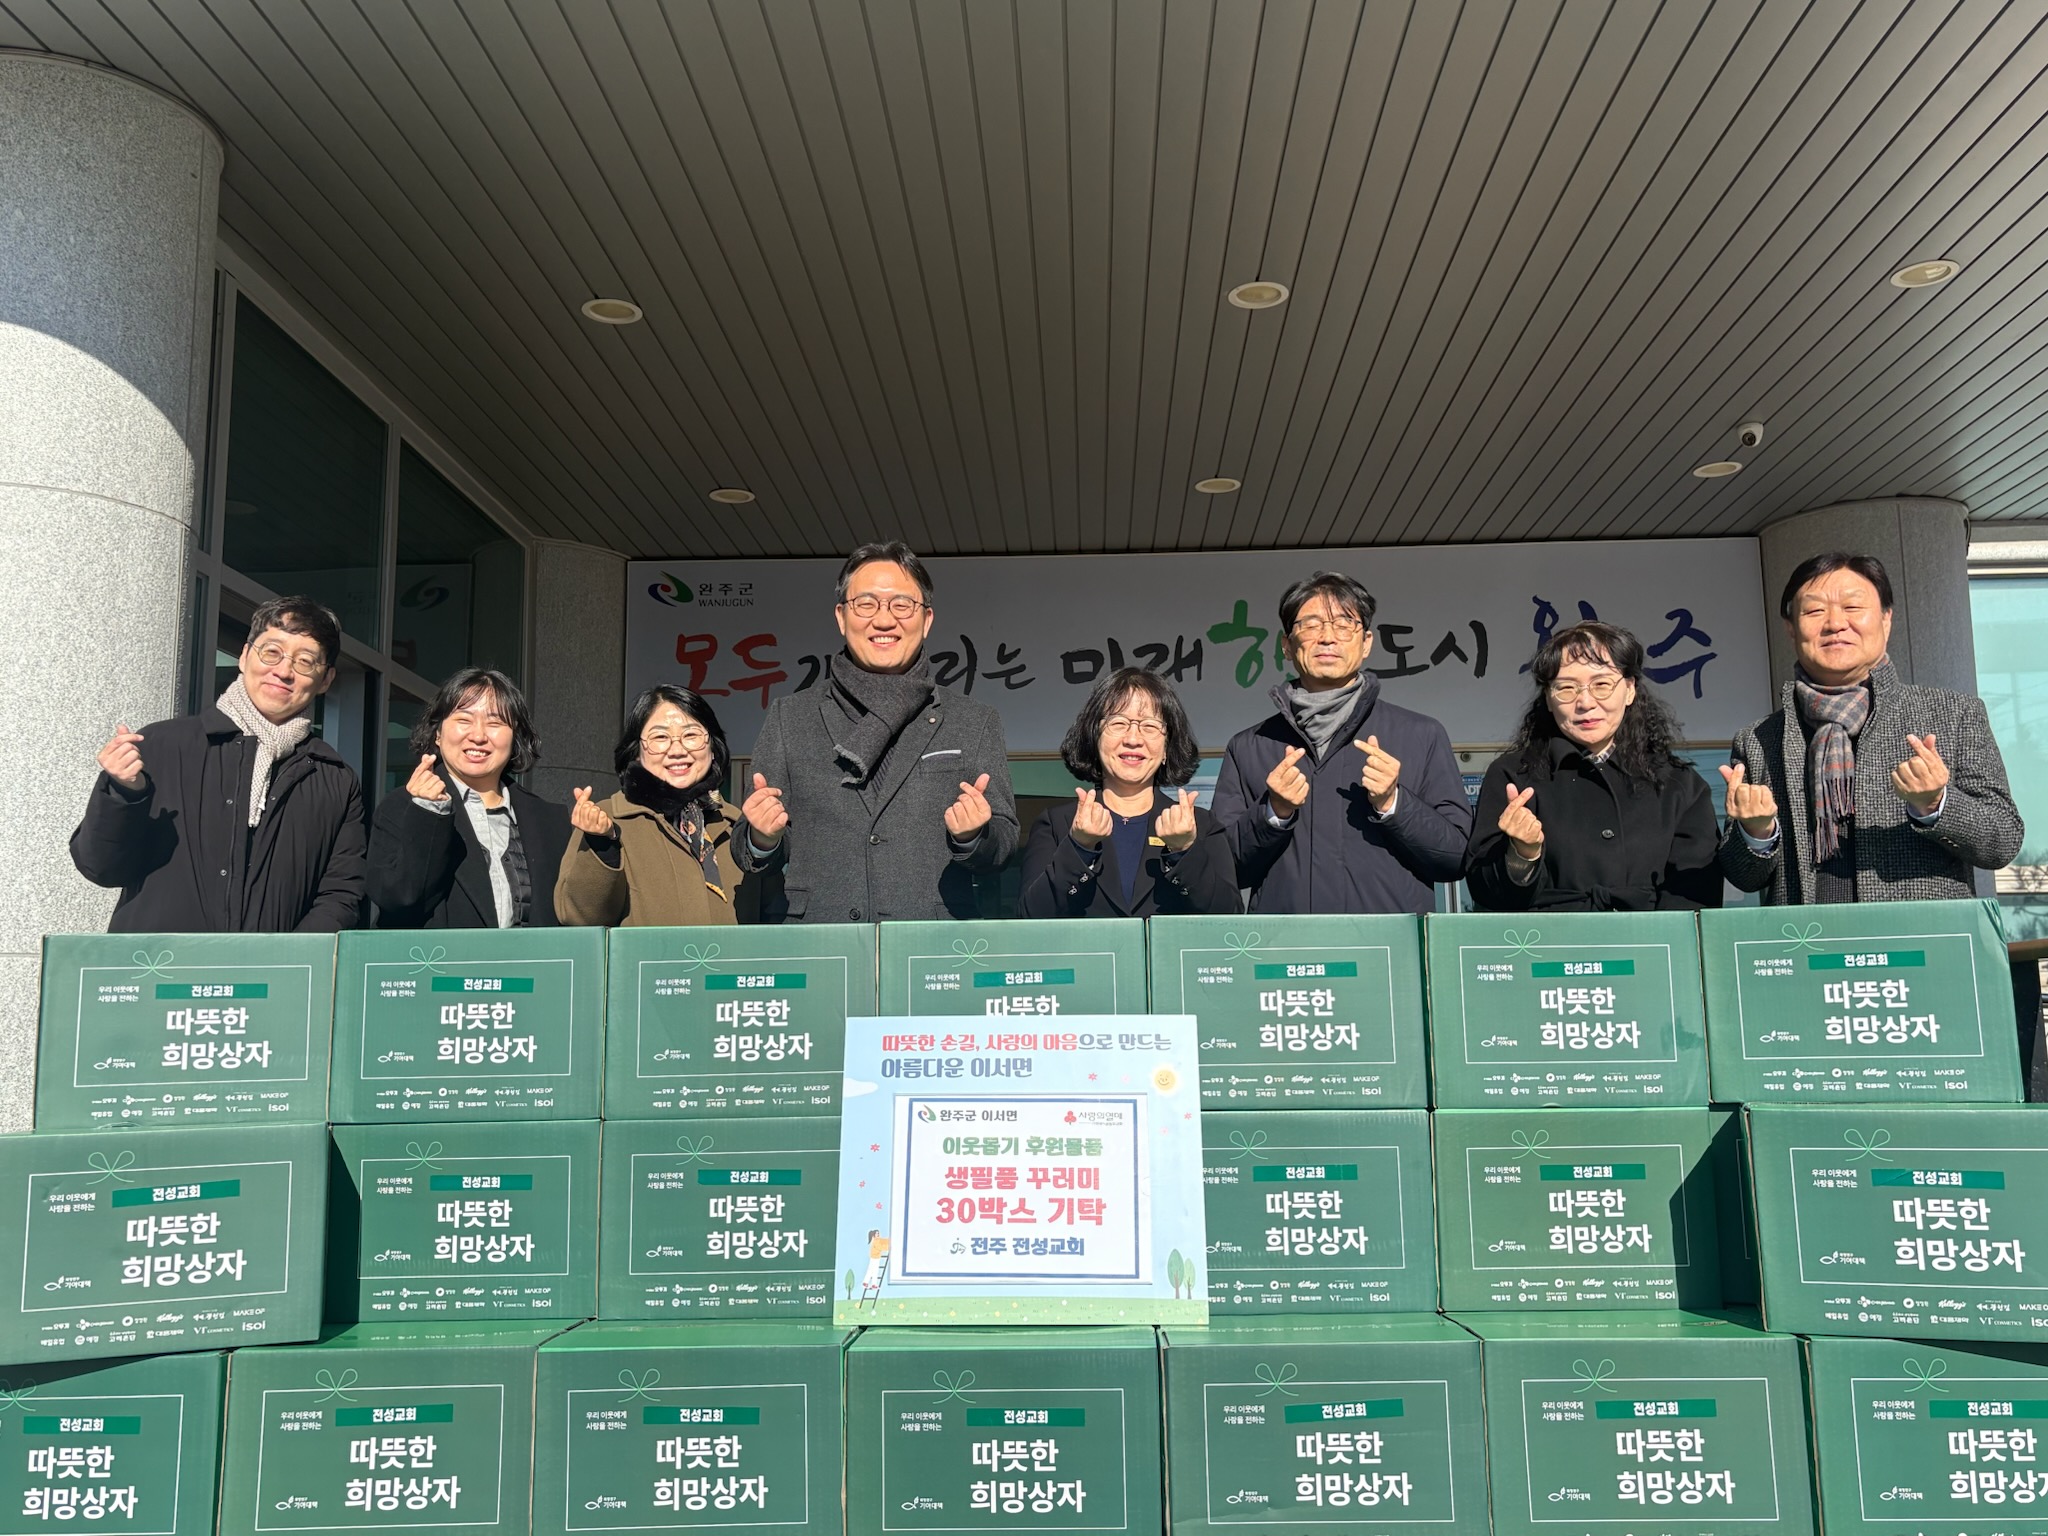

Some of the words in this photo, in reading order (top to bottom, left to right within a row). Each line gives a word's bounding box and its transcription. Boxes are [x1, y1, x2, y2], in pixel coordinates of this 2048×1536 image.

[698, 582, 754, 596] 완주군
[698, 599, 754, 608] WANJUGUN
[932, 634, 1036, 696] 리는
[1287, 964, 1324, 976] 전성교회
[1564, 963, 1602, 974] 전성교회
[1845, 954, 1888, 966] 전성교회
[192, 986, 233, 996] 전성교회
[464, 979, 501, 990] 전성교회
[738, 976, 774, 987] 전성교회
[1006, 972, 1042, 984] 전성교회
[1260, 989, 1335, 1017] 따뜻한
[1541, 987, 1616, 1015] 따뜻한
[1824, 979, 1909, 1009] 따뜻한
[166, 1007, 249, 1036] 따뜻한
[441, 1002, 515, 1030] 따뜻한
[716, 1000, 790, 1028] 따뜻한
[882, 1035, 935, 1051] 따뜻한
[940, 1034, 979, 1051] 손길,
[985, 1034, 1037, 1050] 사랑의
[1044, 1034, 1113, 1050] 마음으로
[1118, 1034, 1171, 1050] 만드는
[1260, 1023, 1360, 1051] 희망상자
[1540, 1021, 1641, 1049] 희망상자
[1825, 1014, 1940, 1044] 희망상자
[162, 1041, 272, 1070] 희망상자
[437, 1036, 537, 1064] 희망상자
[714, 1033, 813, 1062] 희망상자
[881, 1058, 964, 1078] 아름다운
[971, 1058, 1032, 1078] 이서면
[940, 1110, 976, 1121] 완주군
[982, 1110, 1017, 1121] 이서면
[943, 1137, 1018, 1155] 이웃돕기
[1026, 1136, 1103, 1156] 후원물품
[463, 1177, 500, 1188] 전성교회
[731, 1172, 768, 1182] 전성교회
[945, 1167, 1018, 1190] 생필품
[1027, 1168, 1099, 1190] 꾸러미
[1286, 1167, 1324, 1178] 전성교회
[1574, 1166, 1612, 1178] 전성교회
[1913, 1172, 1962, 1185] 전성교회
[66, 1193, 96, 1201] 이웃에게
[153, 1185, 200, 1201] 전성교회
[1266, 1191, 1343, 1219] 따뜻한
[1549, 1189, 1626, 1218] 따뜻한
[49, 1204, 71, 1212] 사랑을
[438, 1200, 512, 1228] 따뜻한
[710, 1194, 785, 1223] 따뜻한
[936, 1197, 1036, 1224] 30박스
[1048, 1198, 1106, 1226] 기탁
[1893, 1198, 1990, 1230] 따뜻한
[127, 1212, 221, 1248] 따뜻한
[1266, 1226, 1368, 1255] 희망상자
[1549, 1224, 1652, 1254] 희망상자
[434, 1234, 535, 1263] 희망상자
[707, 1230, 808, 1259] 희망상자
[971, 1238, 1007, 1255] 전주
[1012, 1237, 1084, 1256] 전성교회
[1894, 1238, 2025, 1272] 희망상자
[121, 1250, 247, 1287] 희망상자
[296, 1411, 322, 1419] 이웃에게
[373, 1408, 416, 1422] 전성교회
[680, 1409, 723, 1422] 전성교회
[1005, 1410, 1048, 1423] 전성교회
[1224, 1416, 1244, 1424] 사랑을
[1322, 1403, 1366, 1418] 전성교회
[1543, 1412, 1562, 1420] 사랑을
[1564, 1412, 1584, 1420] 전하는
[1634, 1402, 1678, 1416] 전성교회
[1968, 1402, 2012, 1416] 전성교회
[60, 1418, 103, 1431] 전성교회
[280, 1422, 300, 1430] 사랑을
[586, 1422, 606, 1430] 사랑을
[350, 1436, 436, 1470] 따뜻한
[657, 1436, 742, 1469] 따뜻한
[973, 1439, 1058, 1472] 따뜻한
[1296, 1432, 1383, 1464] 따뜻한
[1616, 1429, 1704, 1462] 따뜻한
[1948, 1429, 2037, 1462] 따뜻한
[28, 1446, 114, 1479] 따뜻한
[345, 1476, 461, 1511] 희망상자
[654, 1476, 768, 1510] 희망상자
[970, 1480, 1086, 1513] 희망상자
[1296, 1472, 1412, 1506] 희망상자
[1617, 1470, 1736, 1504] 희망상자
[22, 1486, 138, 1520] 희망상자
